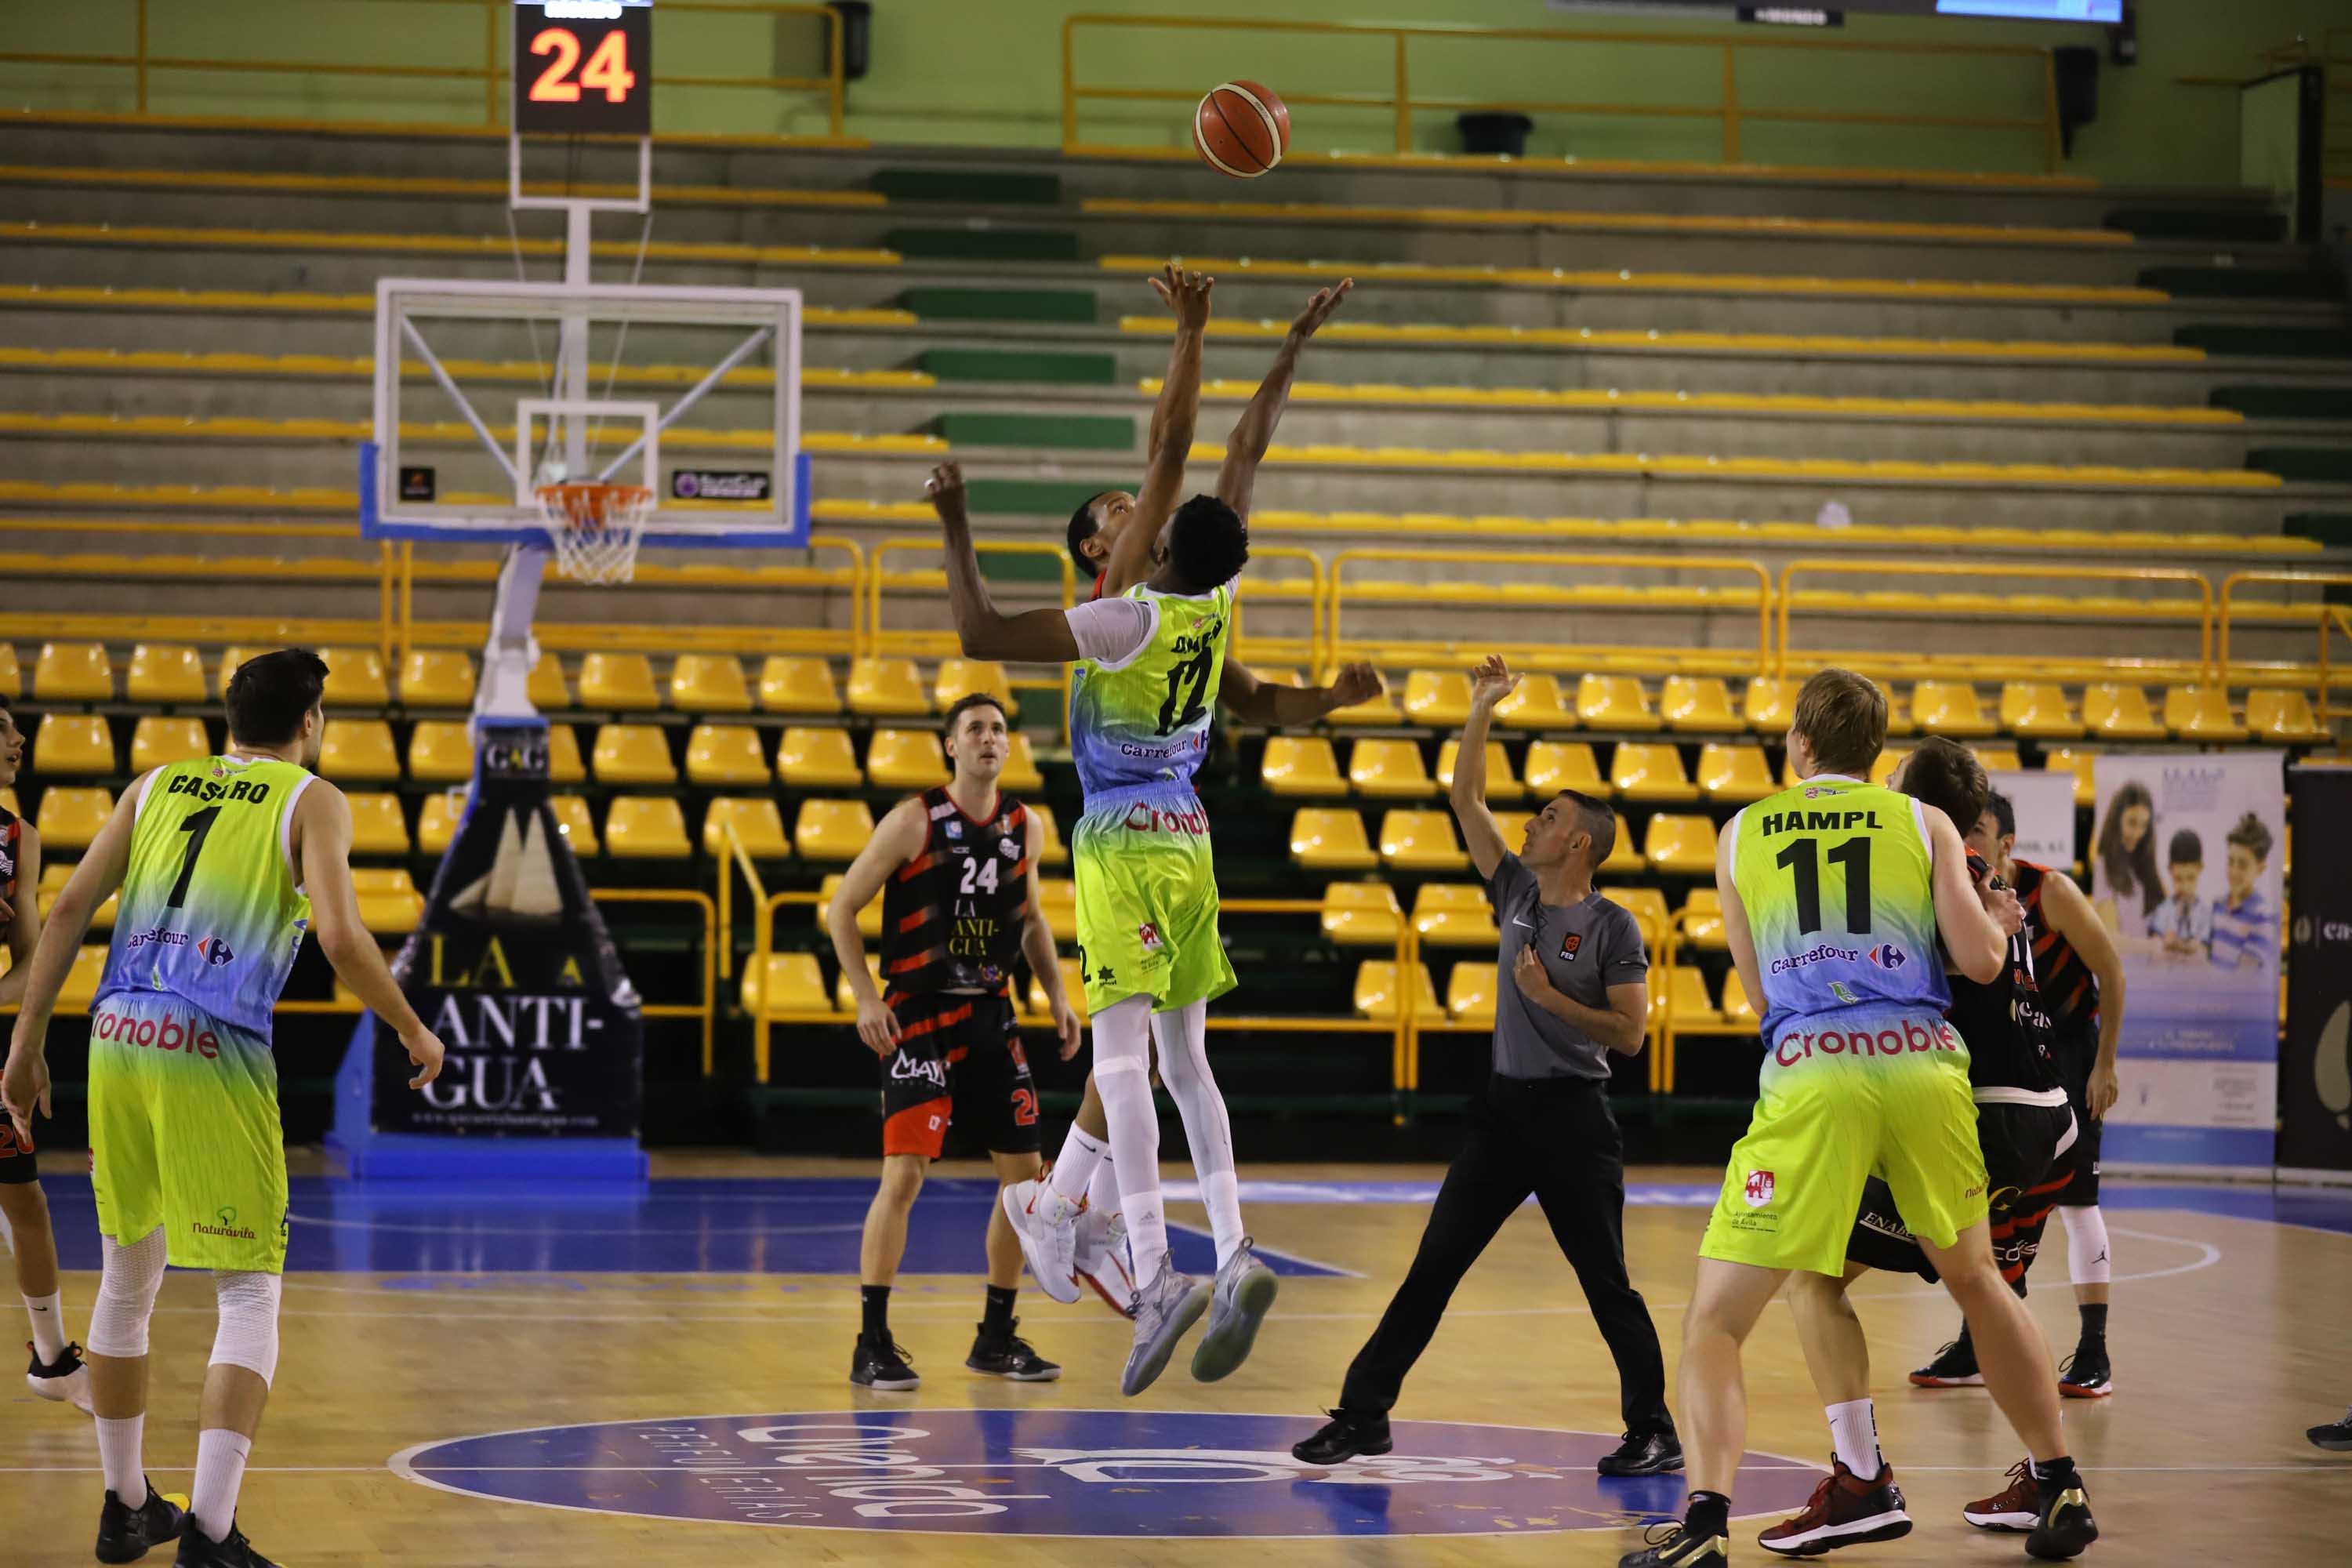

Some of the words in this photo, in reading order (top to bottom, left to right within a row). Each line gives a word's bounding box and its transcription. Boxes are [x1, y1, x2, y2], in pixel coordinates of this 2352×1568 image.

[529, 27, 635, 103] 24
[1762, 811, 1882, 837] HAMPL
[166, 806, 223, 909] 1
[960, 857, 999, 895] 24
[1776, 837, 1871, 935] 11
[428, 935, 516, 988] LA
[1559, 951, 1575, 960] FEB
[1770, 944, 1859, 975] Carrefour
[93, 1007, 220, 1059] ronoble
[430, 993, 604, 1049] ANTI-
[1776, 1020, 1956, 1067] Cronoble
[421, 1054, 562, 1111] GUA
